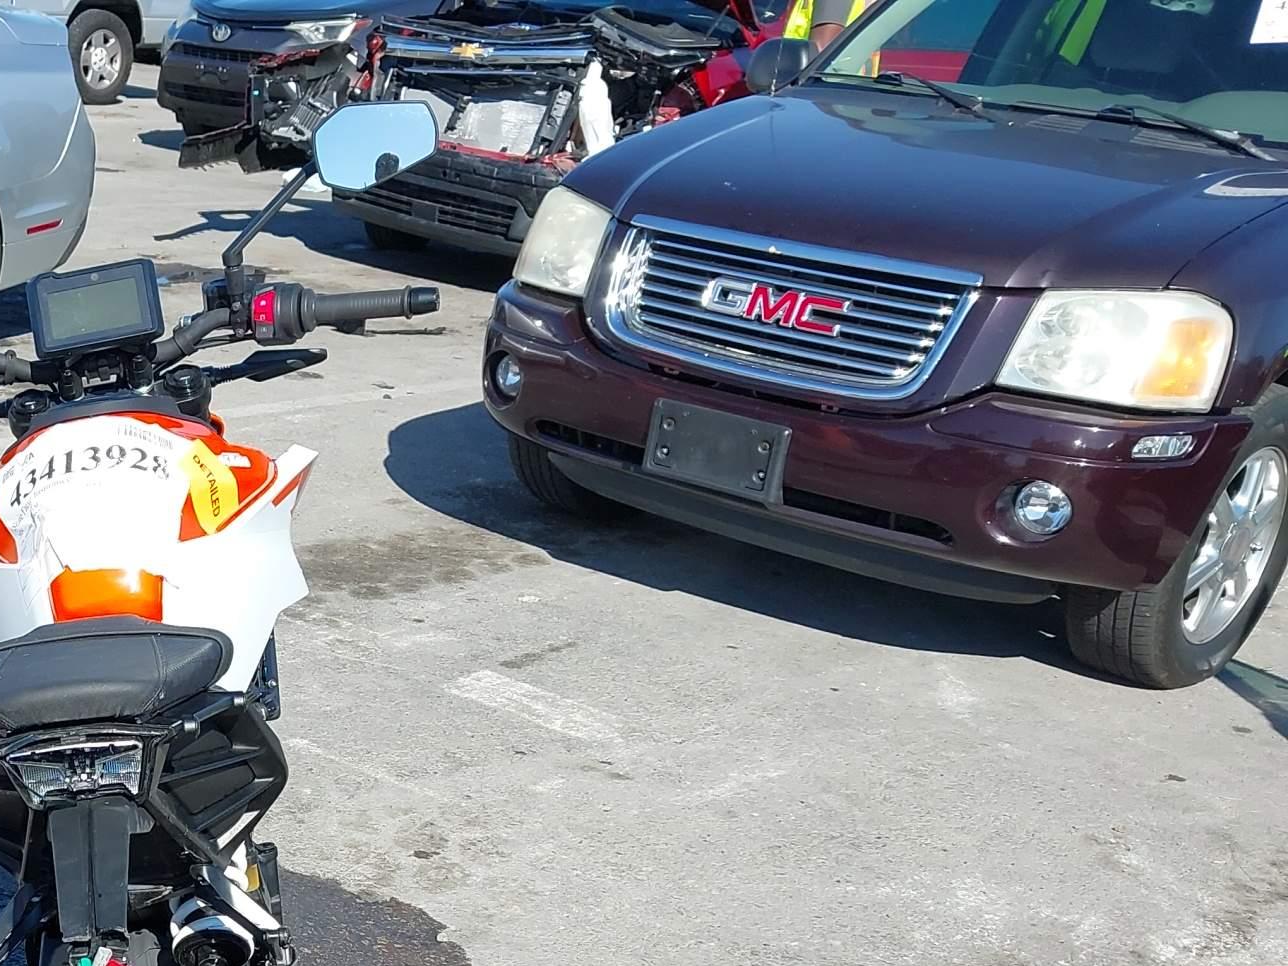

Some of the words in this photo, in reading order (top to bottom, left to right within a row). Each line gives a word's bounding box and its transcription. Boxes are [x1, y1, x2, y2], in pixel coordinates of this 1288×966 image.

[701, 276, 853, 337] GMC
[10, 444, 170, 507] 43413928
[192, 454, 221, 517] DETAILED
